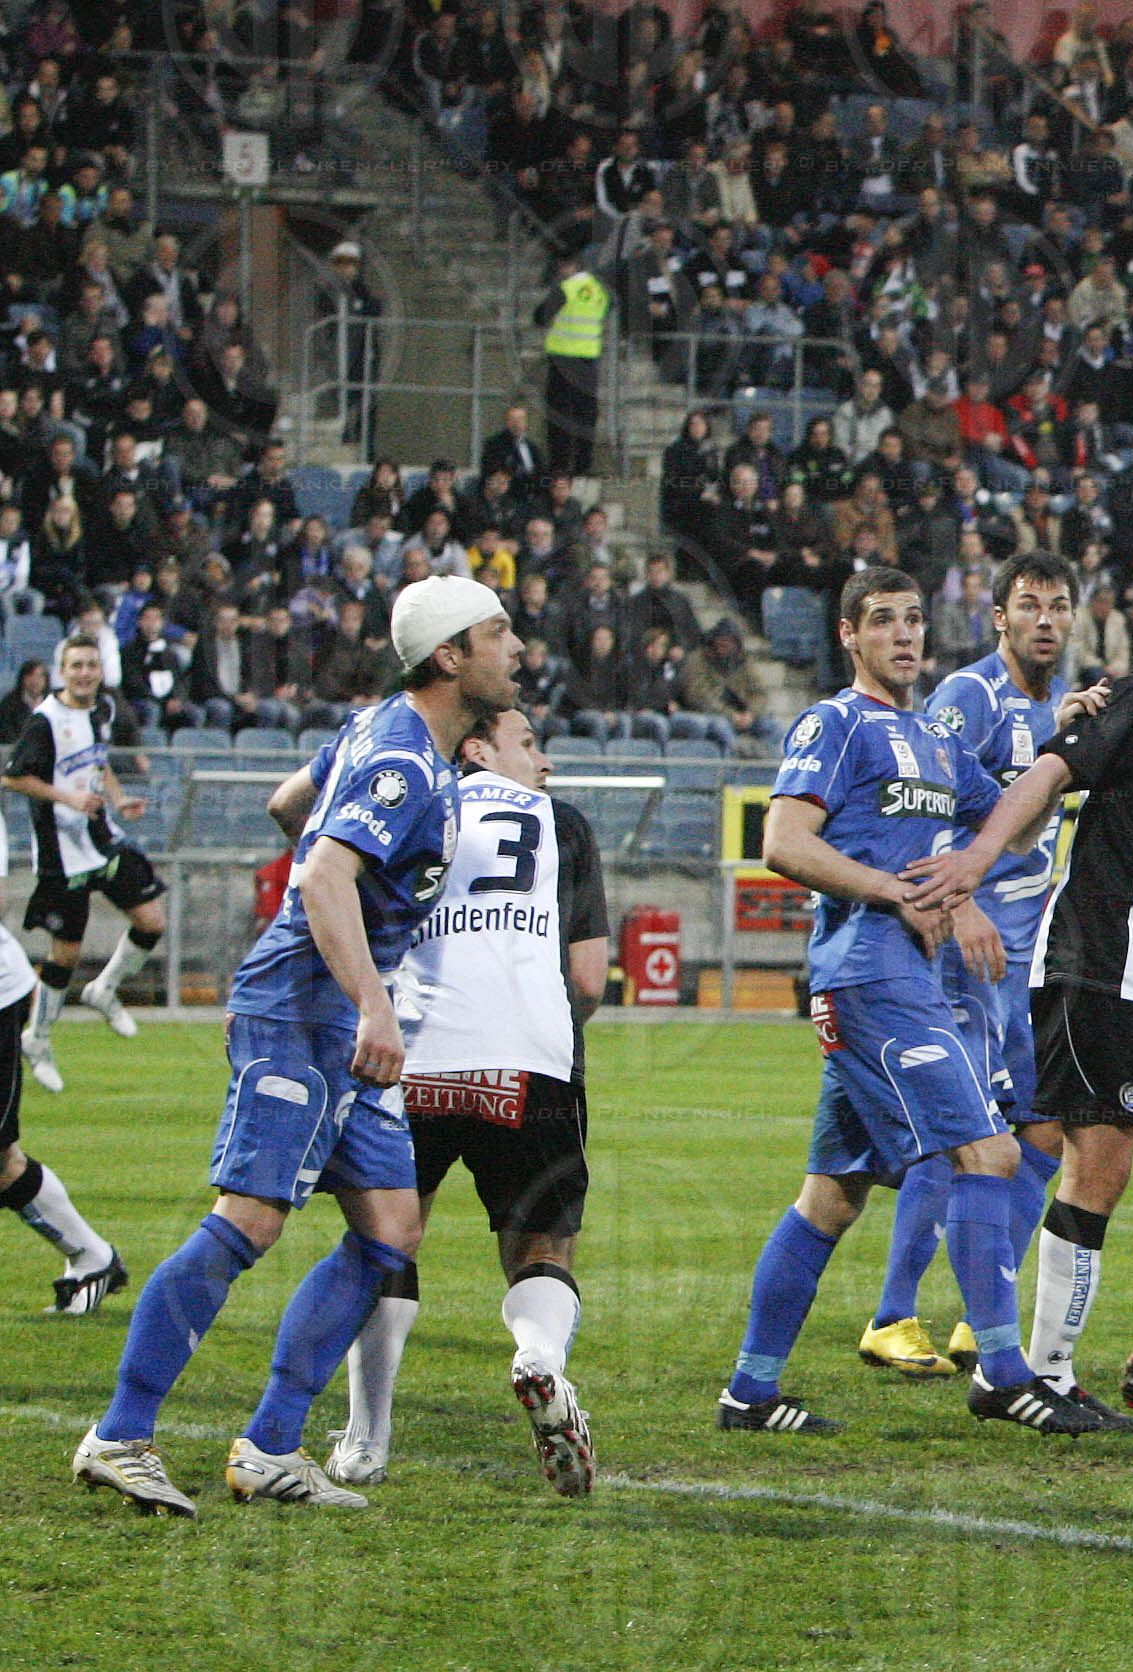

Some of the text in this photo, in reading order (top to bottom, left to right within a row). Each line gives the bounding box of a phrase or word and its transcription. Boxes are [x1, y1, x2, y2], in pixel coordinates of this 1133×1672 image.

[462, 785, 533, 807] AMER
[468, 810, 544, 896] 3
[402, 1085, 518, 1121] ZEITUNG
